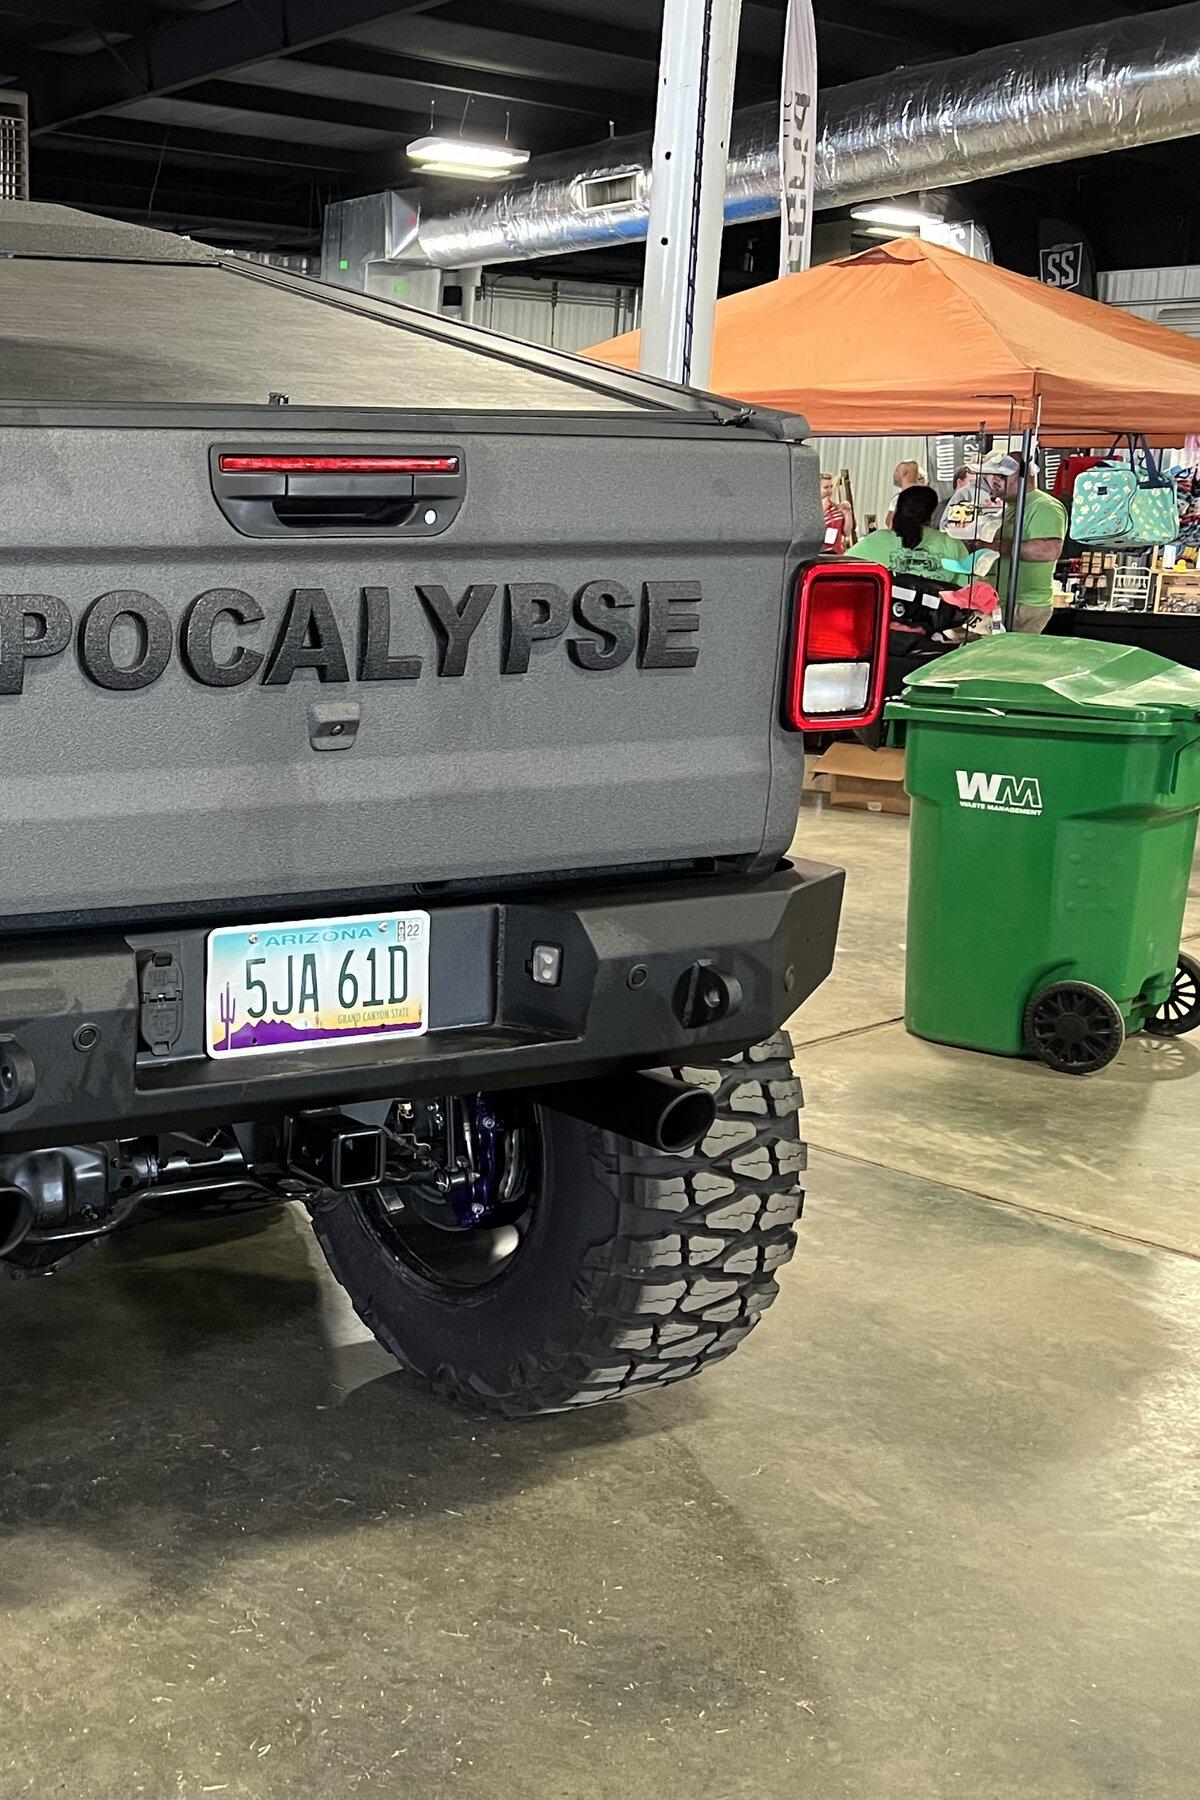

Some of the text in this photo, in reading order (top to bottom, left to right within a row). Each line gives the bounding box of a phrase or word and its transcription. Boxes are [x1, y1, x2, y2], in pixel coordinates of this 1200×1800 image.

[1046, 250, 1075, 287] SS
[955, 770, 1042, 808] WM
[959, 801, 1043, 816] WASTE MANAGEMENT
[264, 927, 373, 947] ARIZONA
[407, 923, 420, 937] 22
[245, 952, 320, 1018] 5JA
[338, 945, 408, 1009] 61D
[337, 1007, 409, 1024] GRAND CANYON STATE
